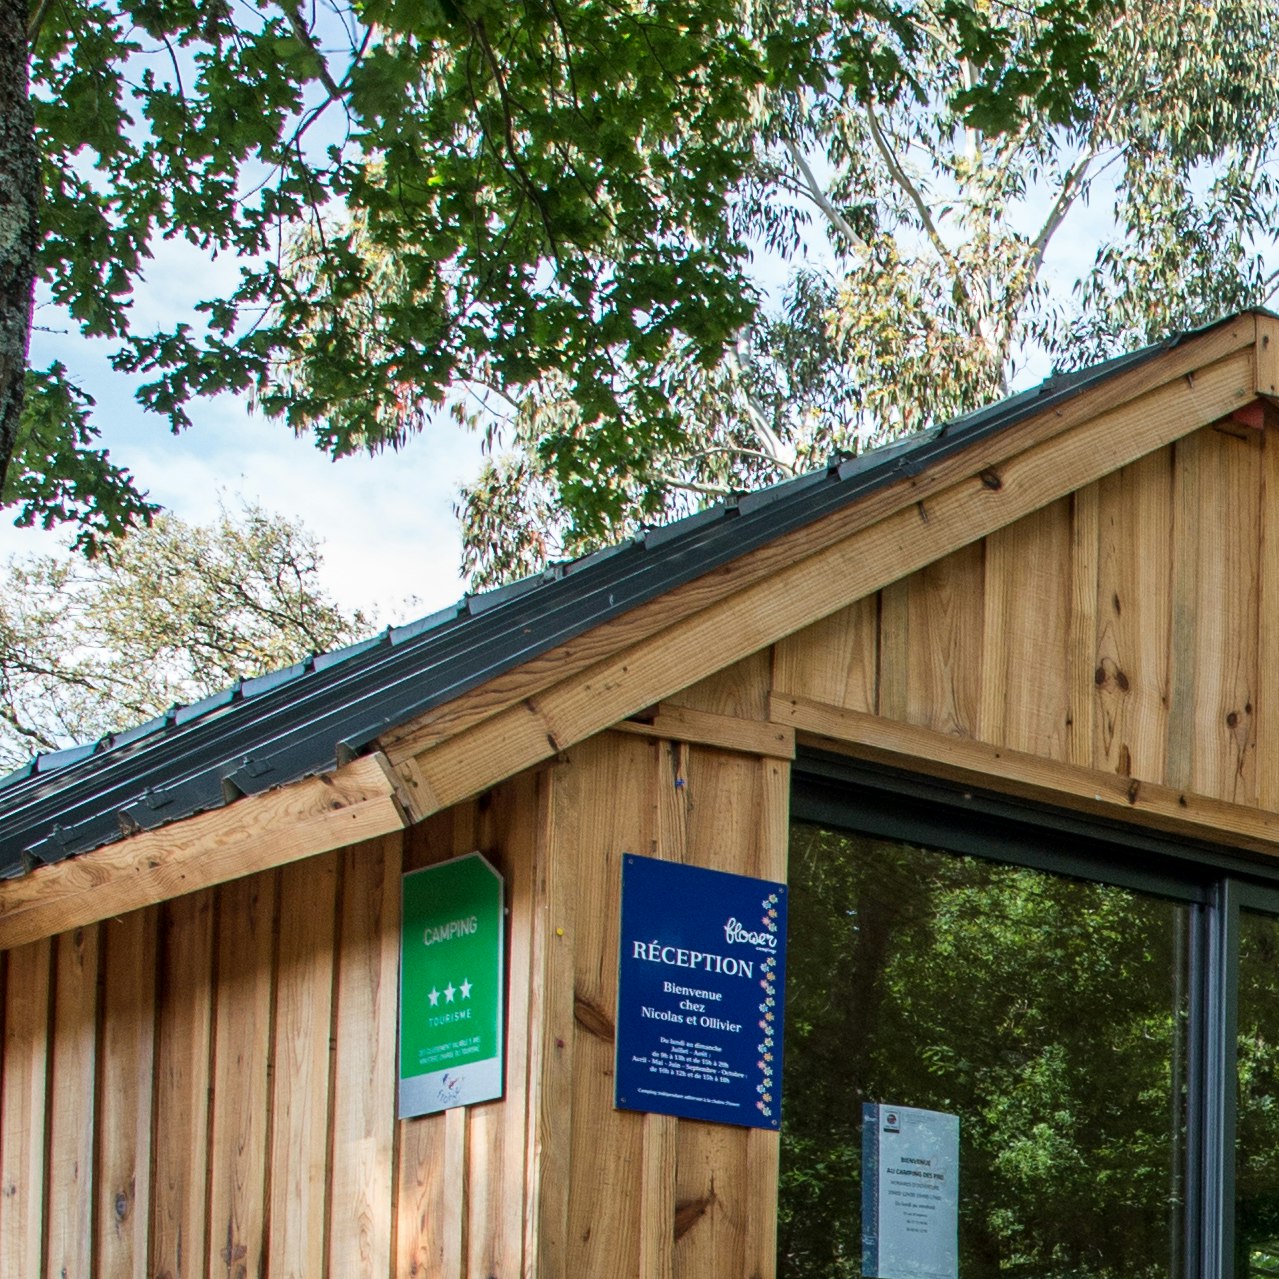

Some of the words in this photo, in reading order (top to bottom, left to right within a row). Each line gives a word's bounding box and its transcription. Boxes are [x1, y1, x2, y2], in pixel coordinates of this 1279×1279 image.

[424, 916, 477, 946] CAMPING
[724, 917, 777, 947] flower
[633, 940, 753, 978] RÉCEPTION
[663, 981, 722, 1001] Bienvenue
[429, 1008, 471, 1027] TOURISME
[641, 1006, 683, 1023] Nicolas
[686, 1016, 697, 1026] et
[701, 1016, 742, 1032] Ollivier
[679, 1000, 705, 1012] chez
